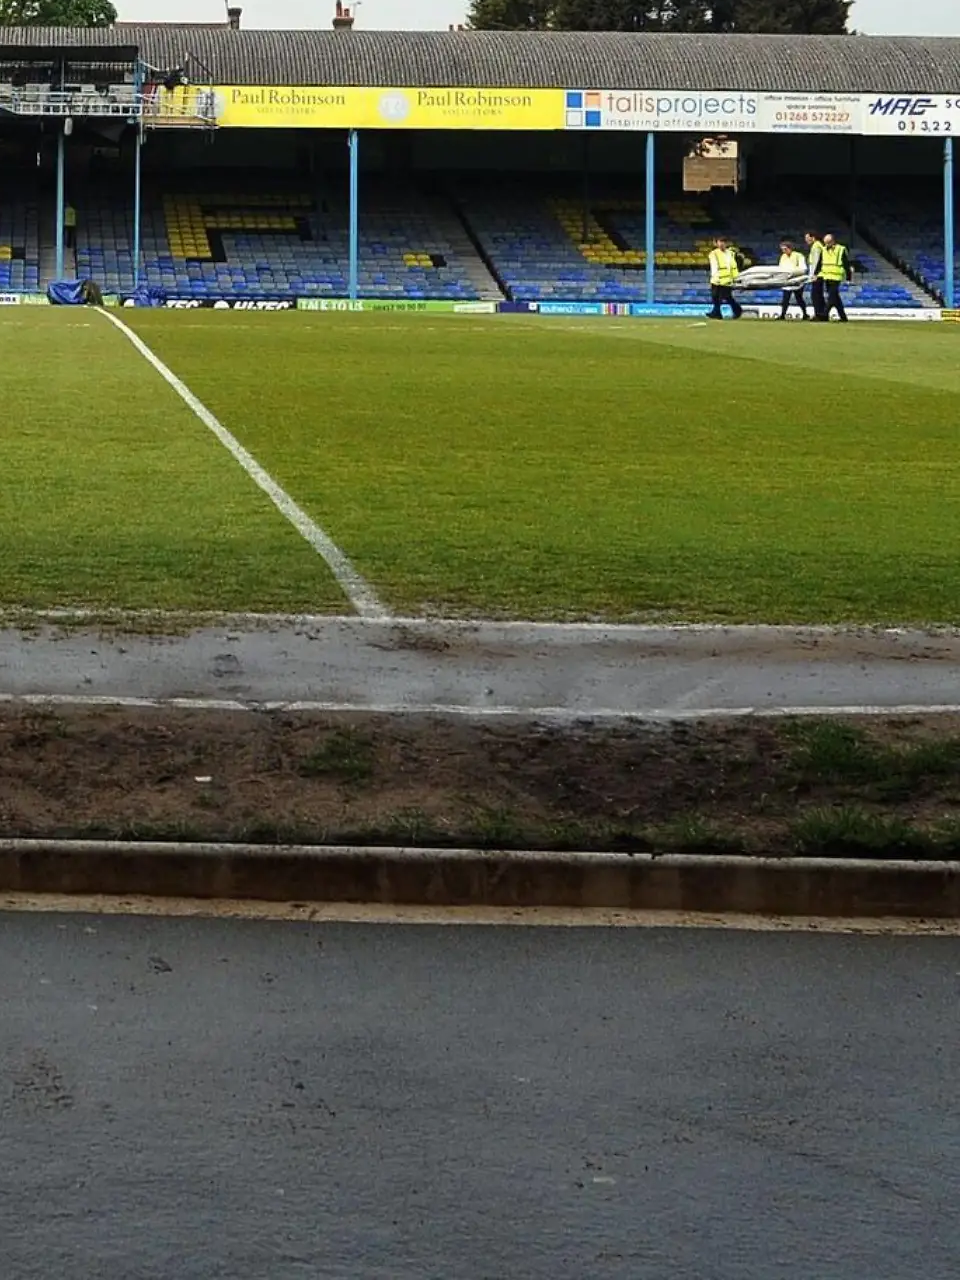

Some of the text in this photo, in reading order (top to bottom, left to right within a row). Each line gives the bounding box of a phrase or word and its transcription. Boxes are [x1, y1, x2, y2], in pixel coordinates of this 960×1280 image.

[231, 89, 346, 105] Paul Robinson
[417, 91, 532, 107] Paul Robinson
[607, 93, 757, 117] talisprojects
[664, 119, 701, 128] office
